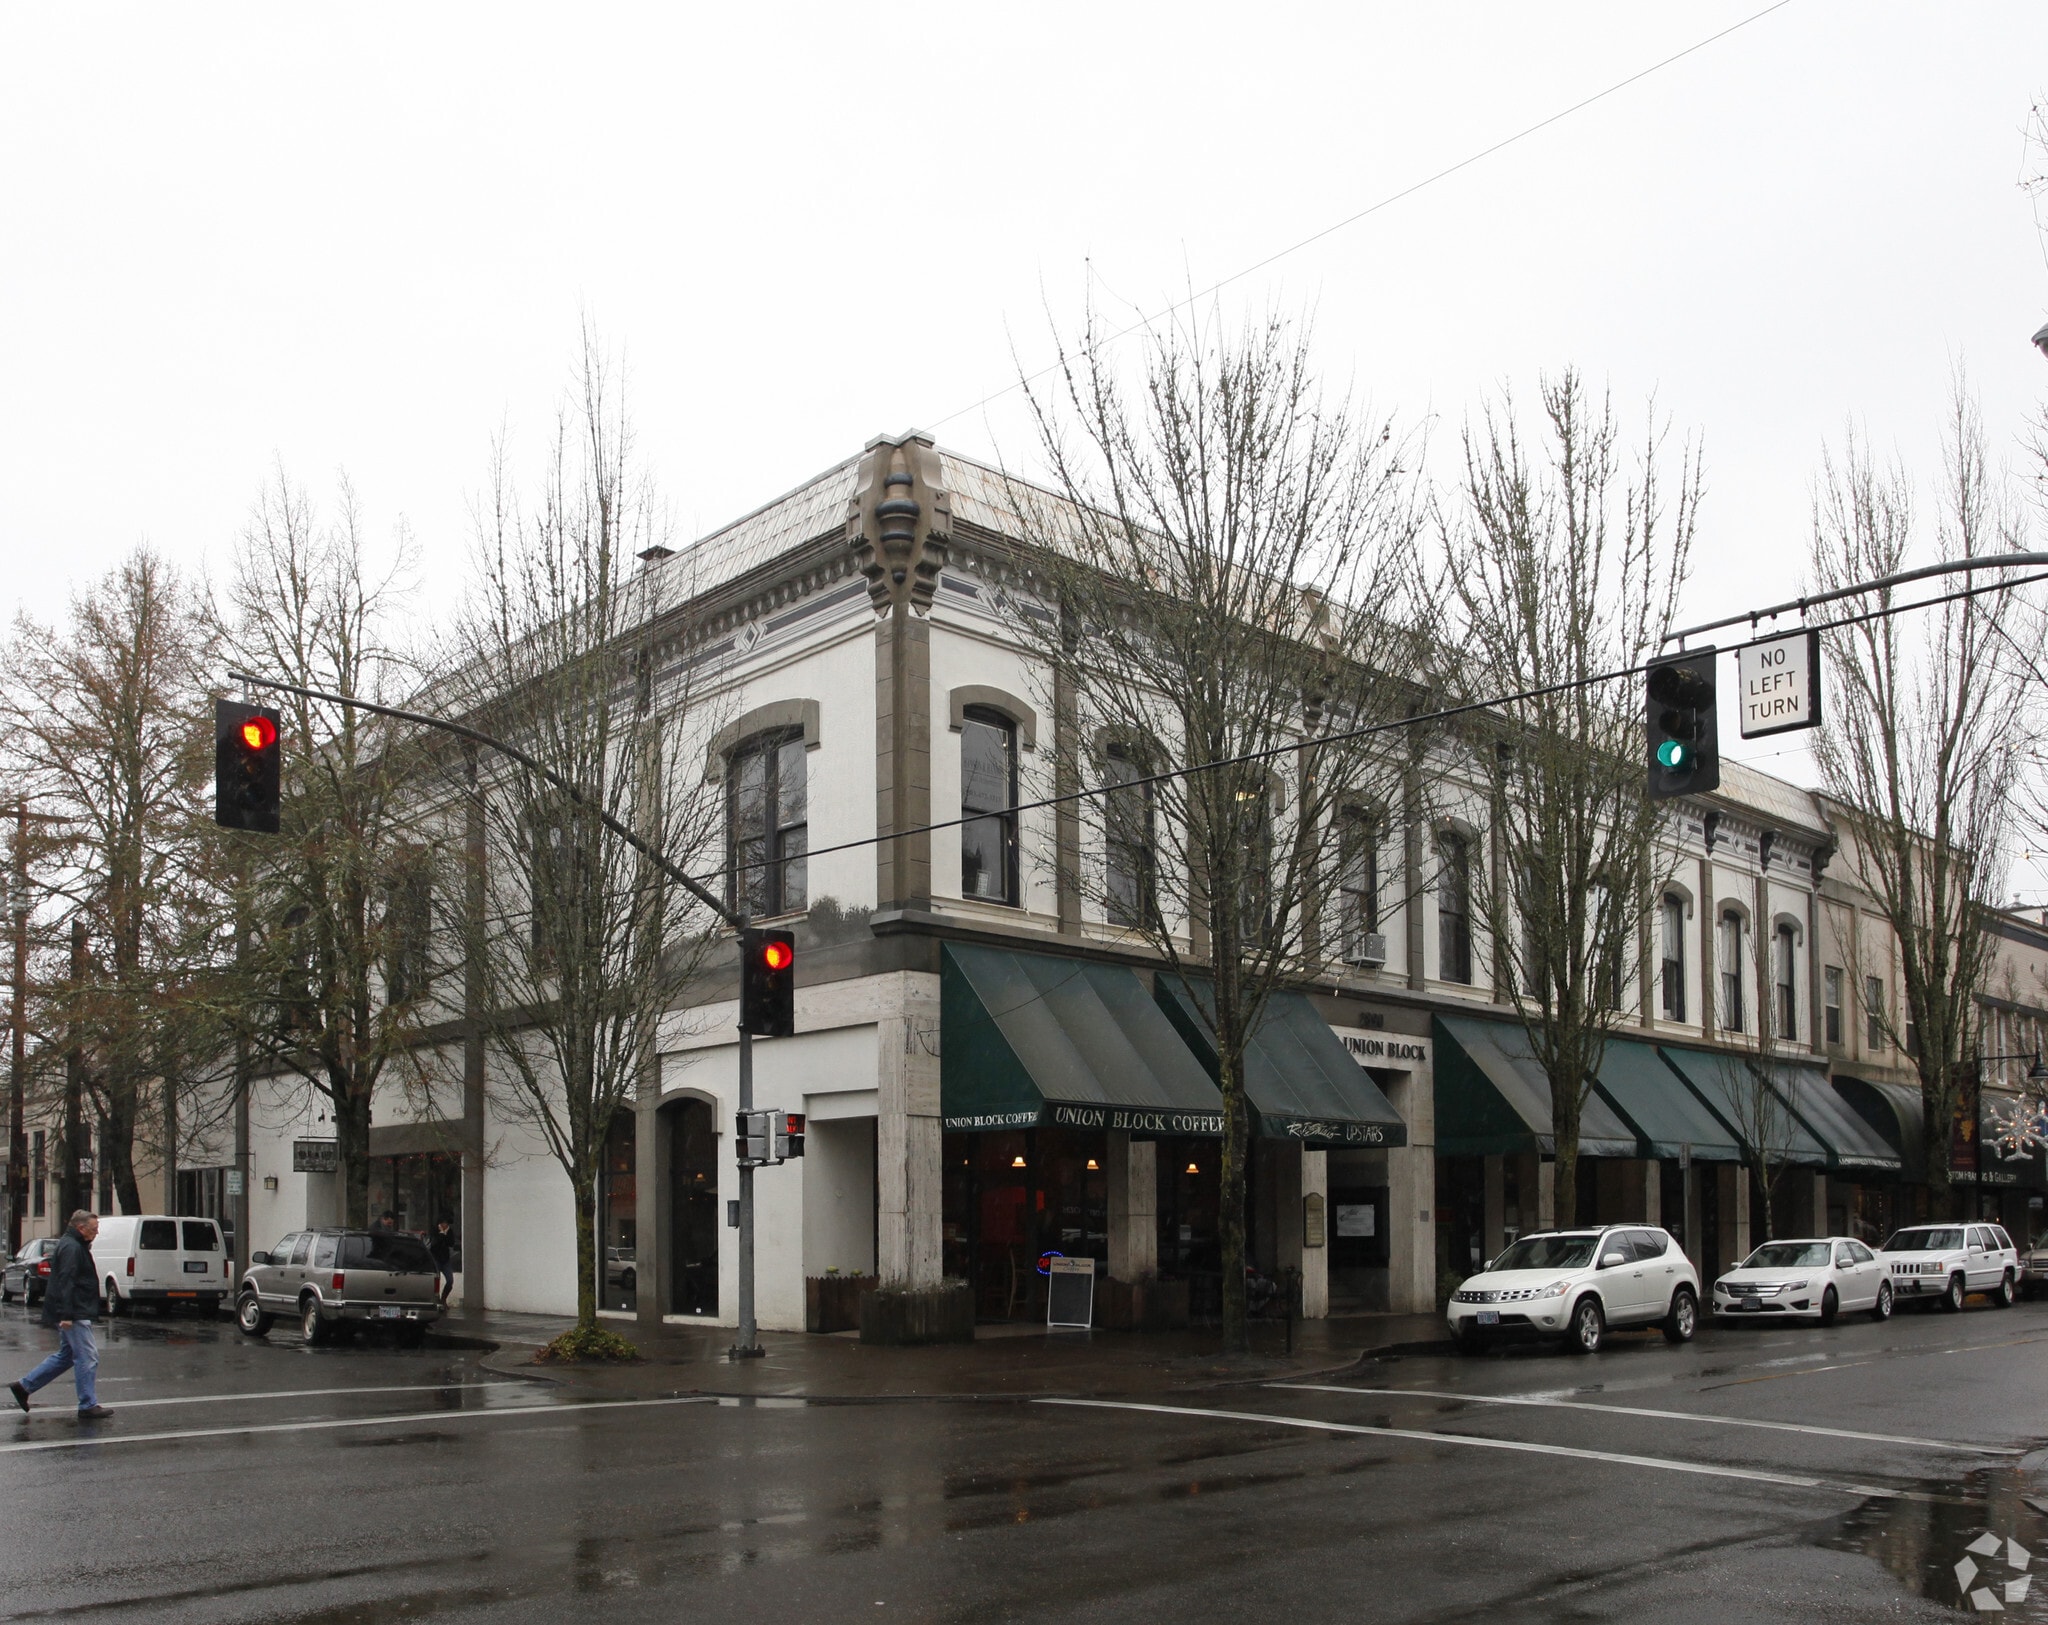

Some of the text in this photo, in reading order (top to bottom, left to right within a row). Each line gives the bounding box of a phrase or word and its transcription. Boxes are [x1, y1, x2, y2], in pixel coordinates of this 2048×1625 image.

[1761, 648, 1785, 668] NO
[1750, 670, 1795, 696] LEFT
[1749, 695, 1799, 721] TURN
[1343, 1036, 1426, 1061] UNION BLOCK
[945, 1111, 1039, 1129] UNION BLOCK COFFEE
[1055, 1107, 1106, 1127] UNION
[1113, 1111, 1167, 1131] BLOCK
[1346, 1123, 1384, 1143] UPSTAIRS
